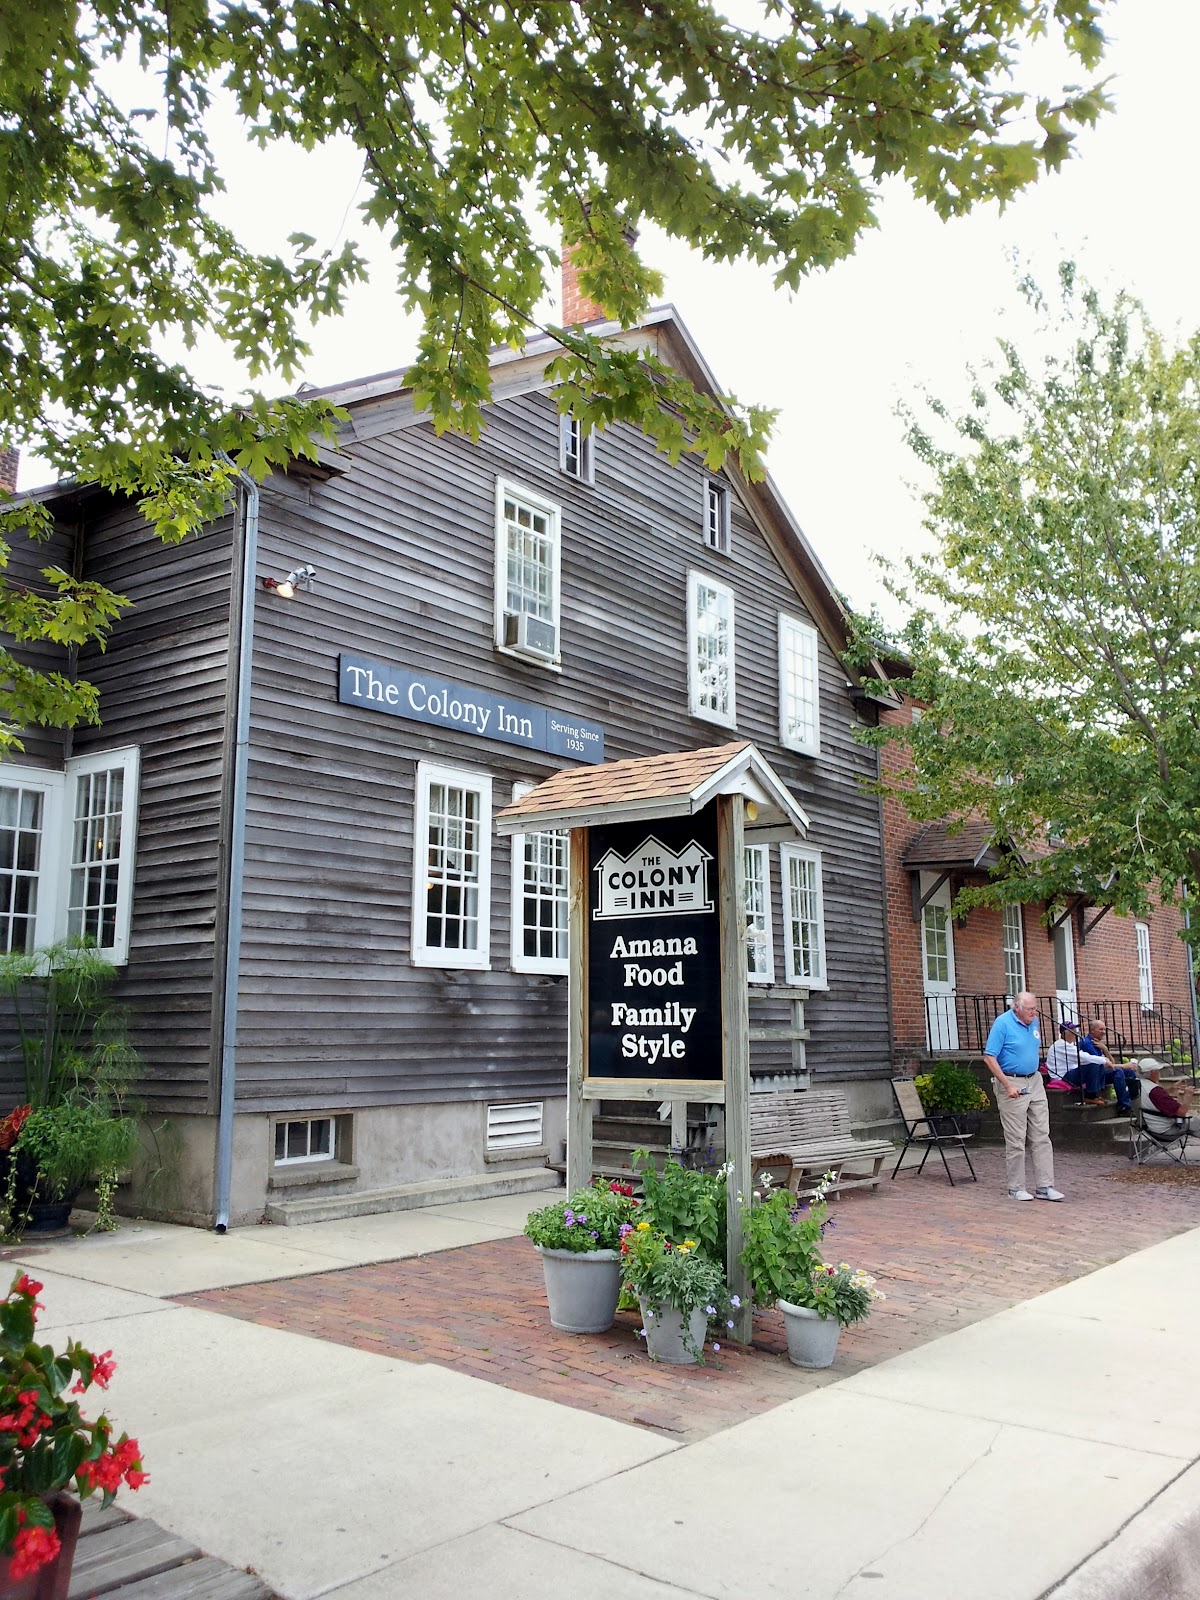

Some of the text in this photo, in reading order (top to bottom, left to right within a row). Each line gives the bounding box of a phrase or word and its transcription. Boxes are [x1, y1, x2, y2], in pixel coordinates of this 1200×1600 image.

[346, 665, 533, 738] The Colony Inn
[551, 719, 600, 742] Serving Since
[566, 738, 584, 752] 1935
[641, 856, 661, 866] THE
[608, 865, 700, 889] COLONY
[630, 889, 675, 909] INN
[609, 935, 698, 959] Amana
[623, 961, 685, 987] Food
[611, 1001, 697, 1033] Family
[621, 1033, 686, 1065] Style
